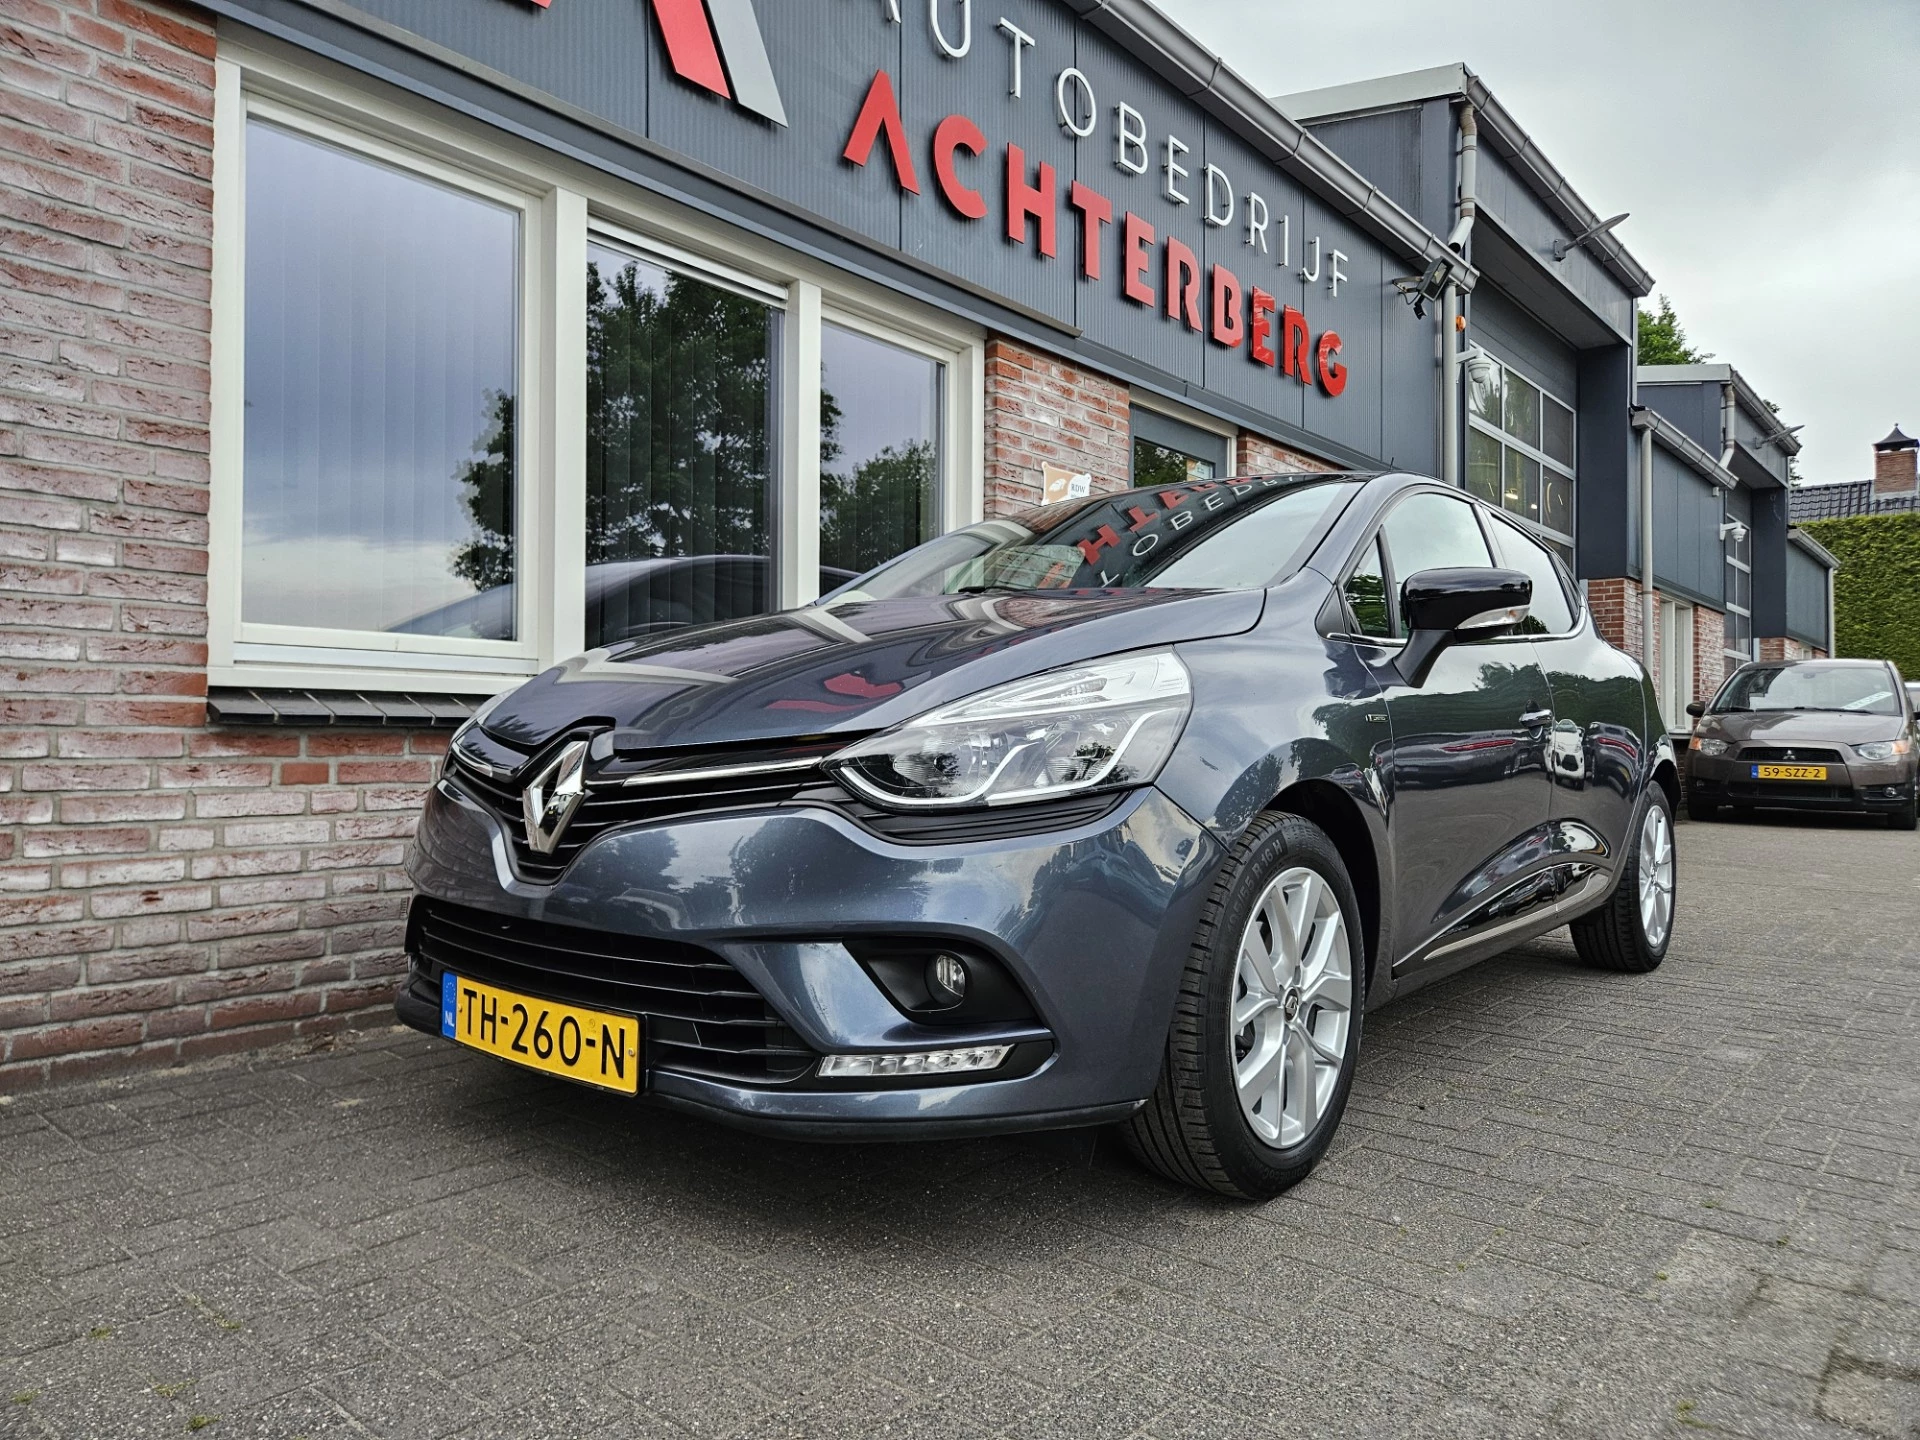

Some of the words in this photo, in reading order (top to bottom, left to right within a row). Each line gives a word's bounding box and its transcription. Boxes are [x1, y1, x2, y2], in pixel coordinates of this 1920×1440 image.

[886, 0, 1348, 297] UTOBEDRIJF
[843, 69, 1348, 397] ACHTERBERG
[1763, 767, 1820, 778] 59-SZZ-2
[1261, 848, 1274, 867] 16
[1272, 839, 1283, 855] H
[444, 1010, 455, 1028] NL
[463, 987, 625, 1079] TH-260-N
